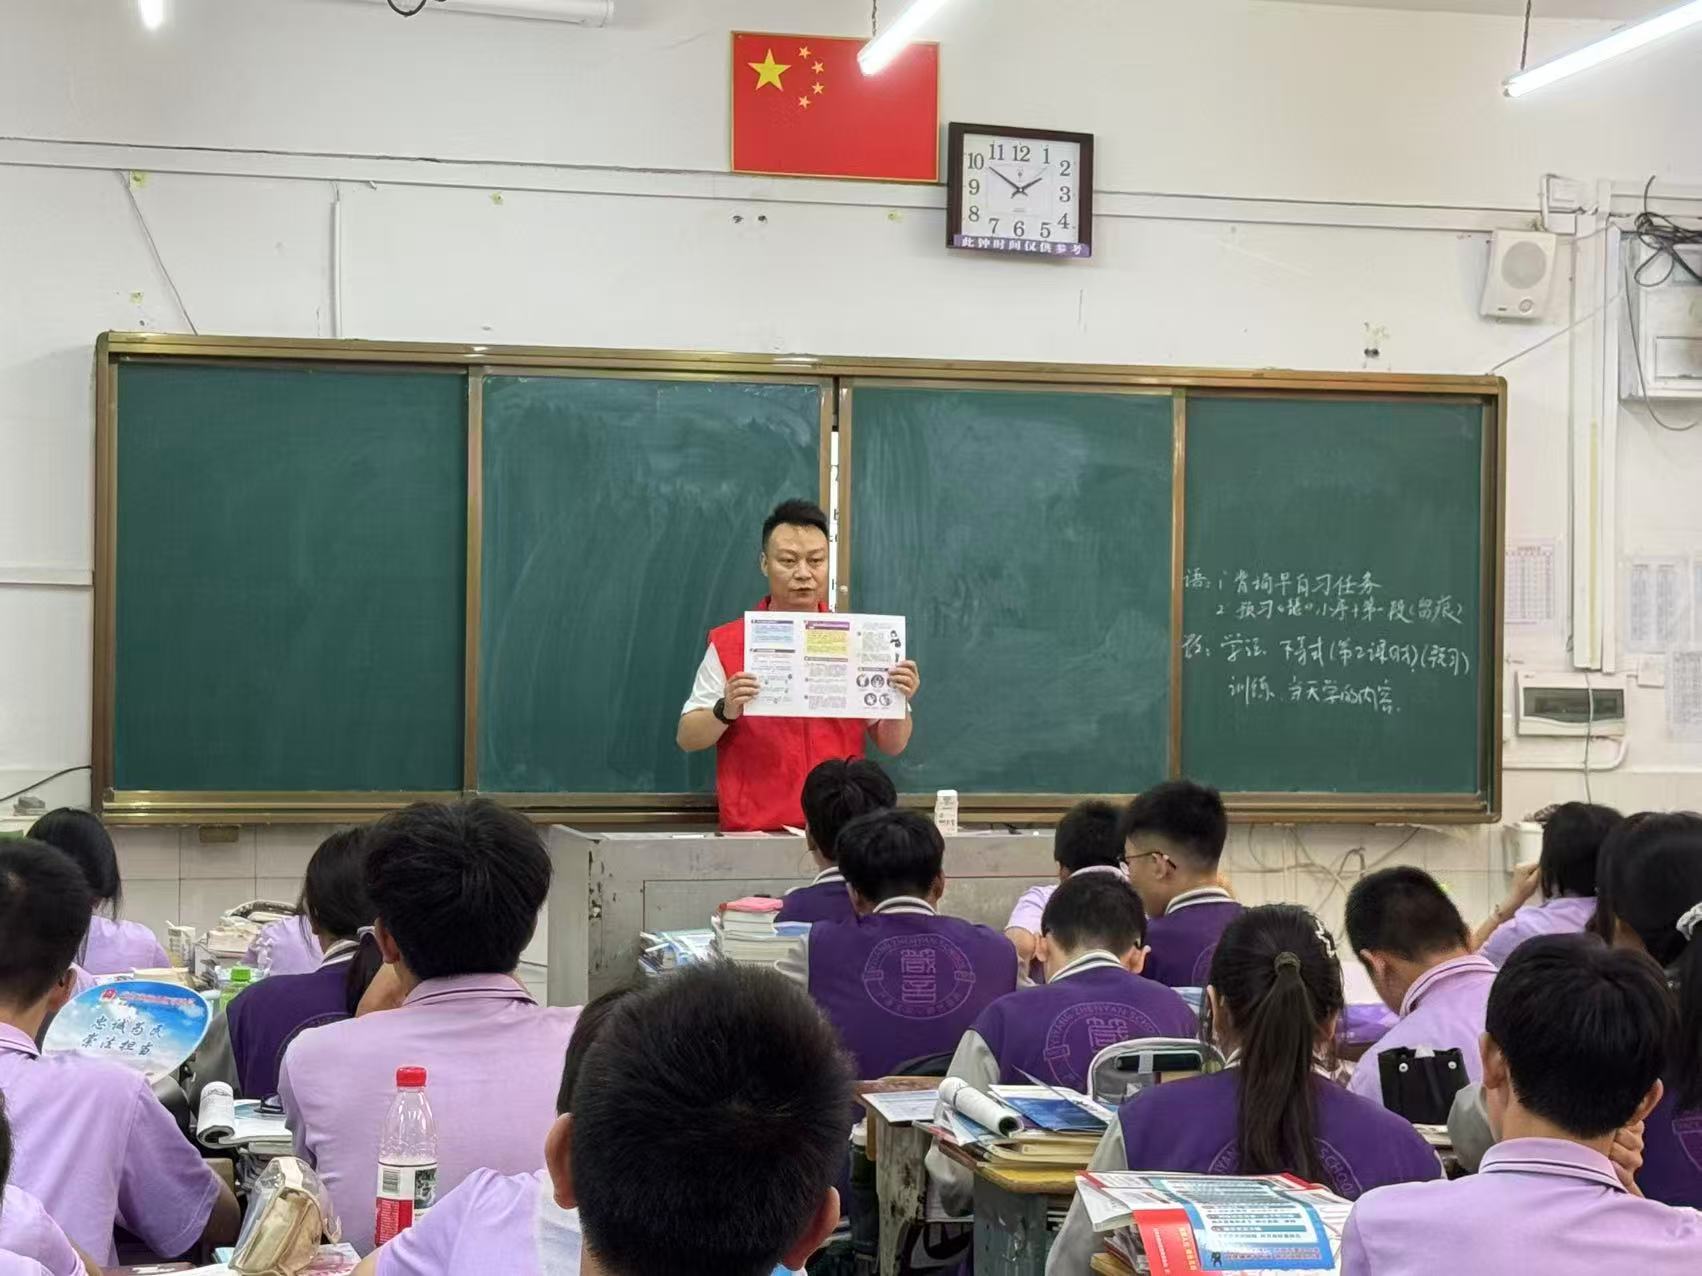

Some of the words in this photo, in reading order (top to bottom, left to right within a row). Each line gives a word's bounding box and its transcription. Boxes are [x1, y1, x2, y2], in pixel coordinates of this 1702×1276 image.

[989, 144, 1005, 160] 11
[1012, 145, 1030, 161] 12
[1043, 148, 1050, 164] 1
[967, 153, 984, 170] 10
[1059, 160, 1071, 176] 2
[969, 179, 980, 195] 9
[1059, 186, 1071, 202] 3
[968, 206, 980, 222] 8
[1057, 213, 1070, 229] 4
[988, 218, 1000, 234] 7
[1013, 221, 1025, 237] 6
[1039, 222, 1051, 238] 5
[961, 238, 1082, 254] 此钟时间仅供参考
